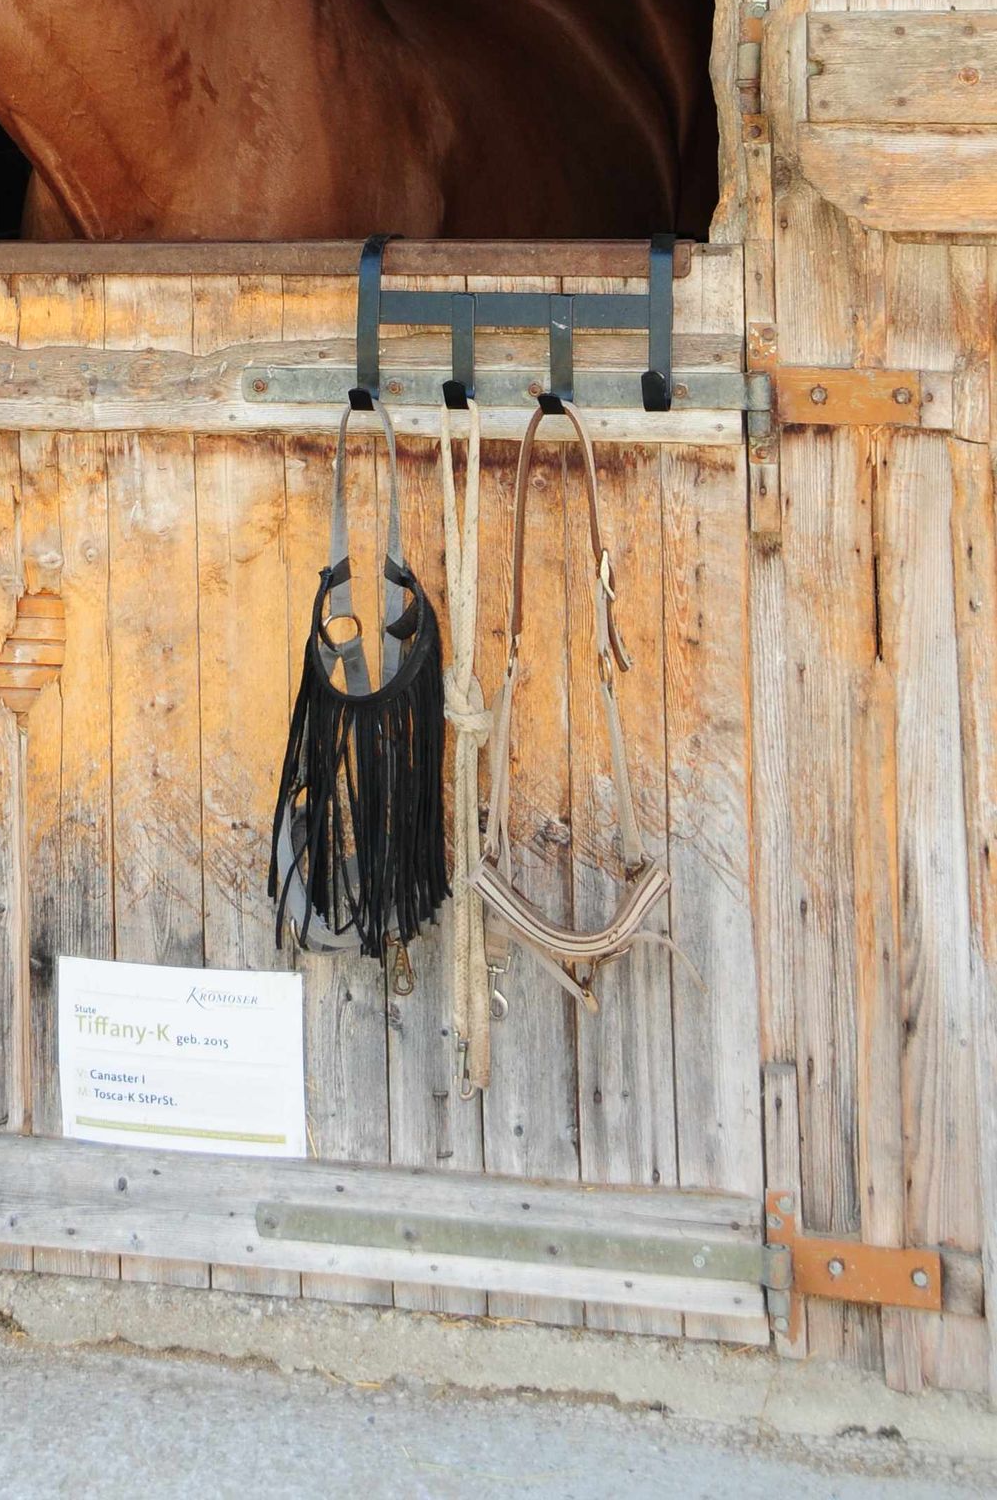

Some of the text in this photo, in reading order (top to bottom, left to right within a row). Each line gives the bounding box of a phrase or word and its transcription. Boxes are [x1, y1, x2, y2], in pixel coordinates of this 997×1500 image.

[74, 1003, 97, 1014] Stute
[75, 1014, 229, 1049] Tiffany-K geb. 2015
[90, 1068, 139, 1084] Canaster
[94, 1088, 135, 1103] Tosca-K
[138, 1090, 178, 1107] StPrSt.
